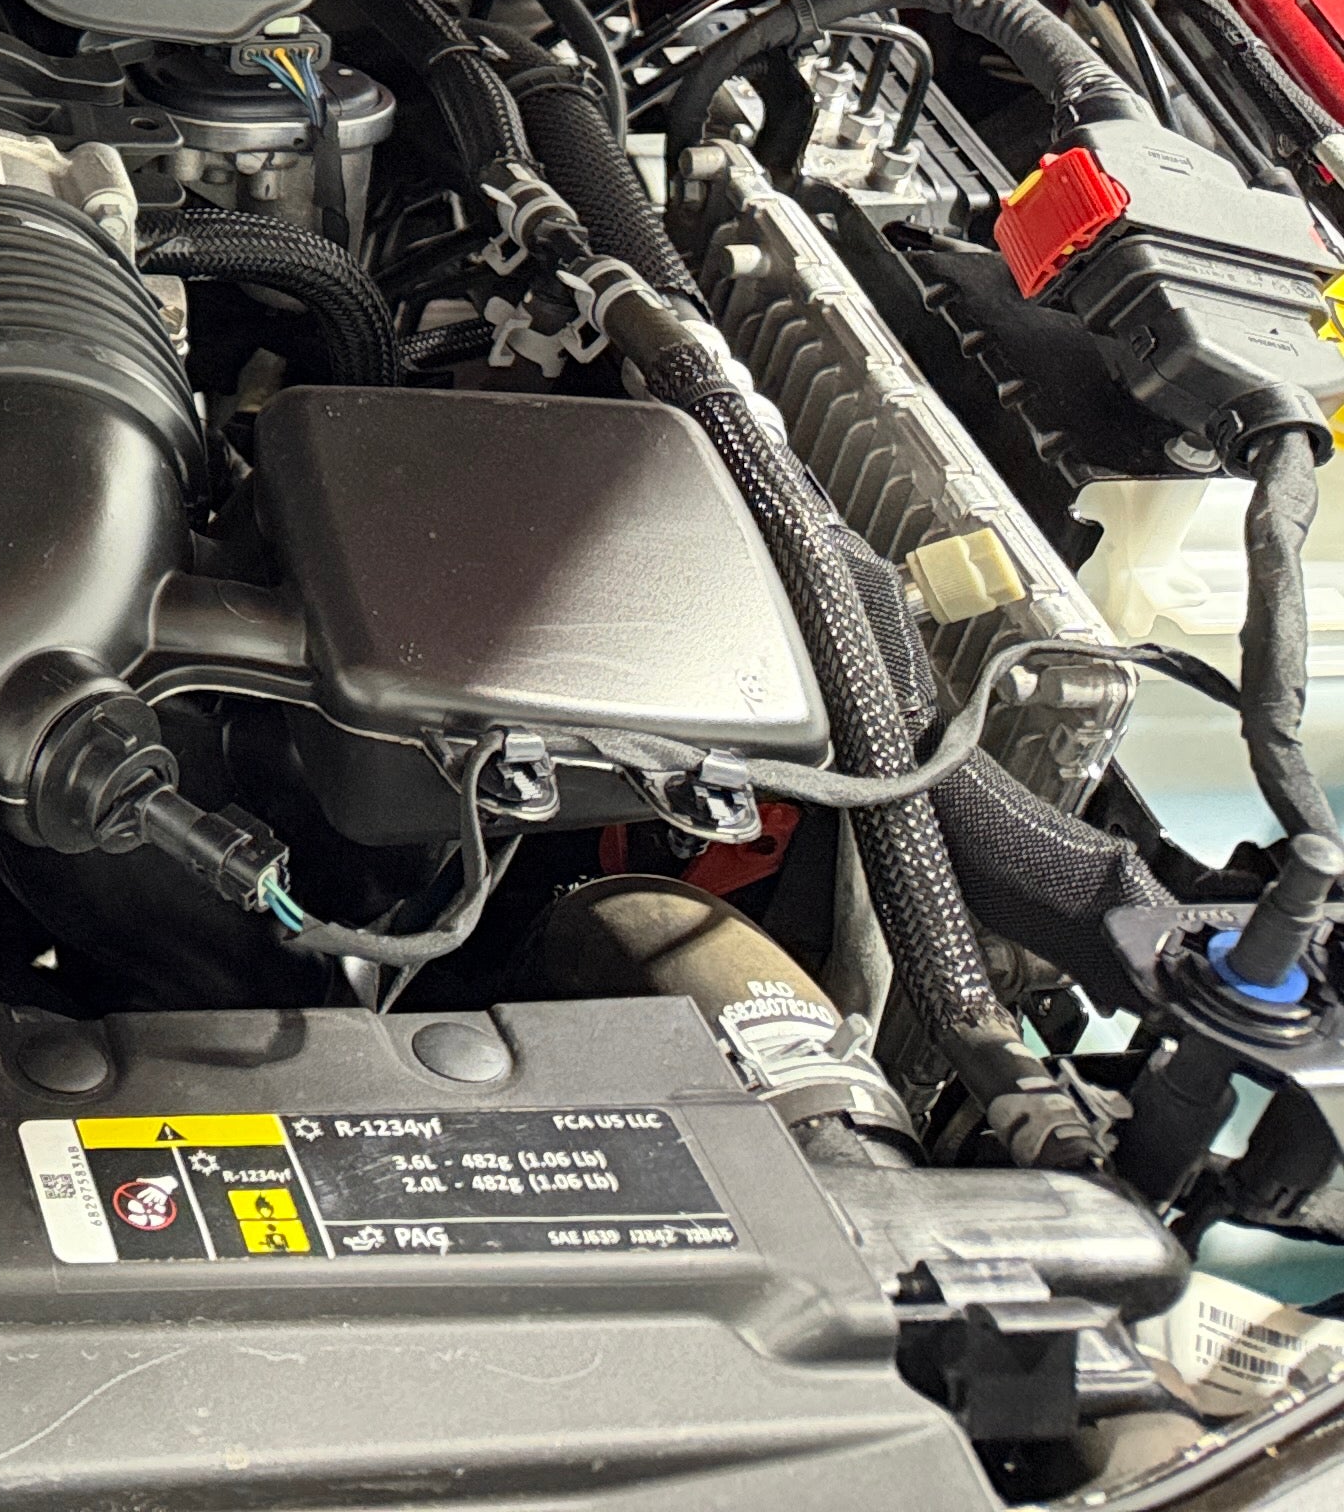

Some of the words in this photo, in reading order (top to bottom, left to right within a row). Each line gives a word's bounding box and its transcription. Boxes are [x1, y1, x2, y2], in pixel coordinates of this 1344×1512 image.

[747, 980, 795, 998] RAD
[334, 1117, 443, 1139] R-1234yf
[552, 1114, 594, 1131] FCA
[594, 1113, 625, 1129] US
[625, 1113, 663, 1129] LLC
[391, 1155, 438, 1171] 3.6L
[462, 1153, 513, 1172] 482g
[517, 1150, 573, 1172] (1.06
[573, 1149, 608, 1170] Lb)
[67, 1146, 103, 1227] 68297583AB
[222, 1168, 292, 1184] R-1234yf
[401, 1176, 449, 1193] 2.0L
[471, 1175, 524, 1194] 482g
[528, 1173, 584, 1194] (1.06
[584, 1172, 620, 1193] Lb)
[394, 1226, 453, 1248] PAG
